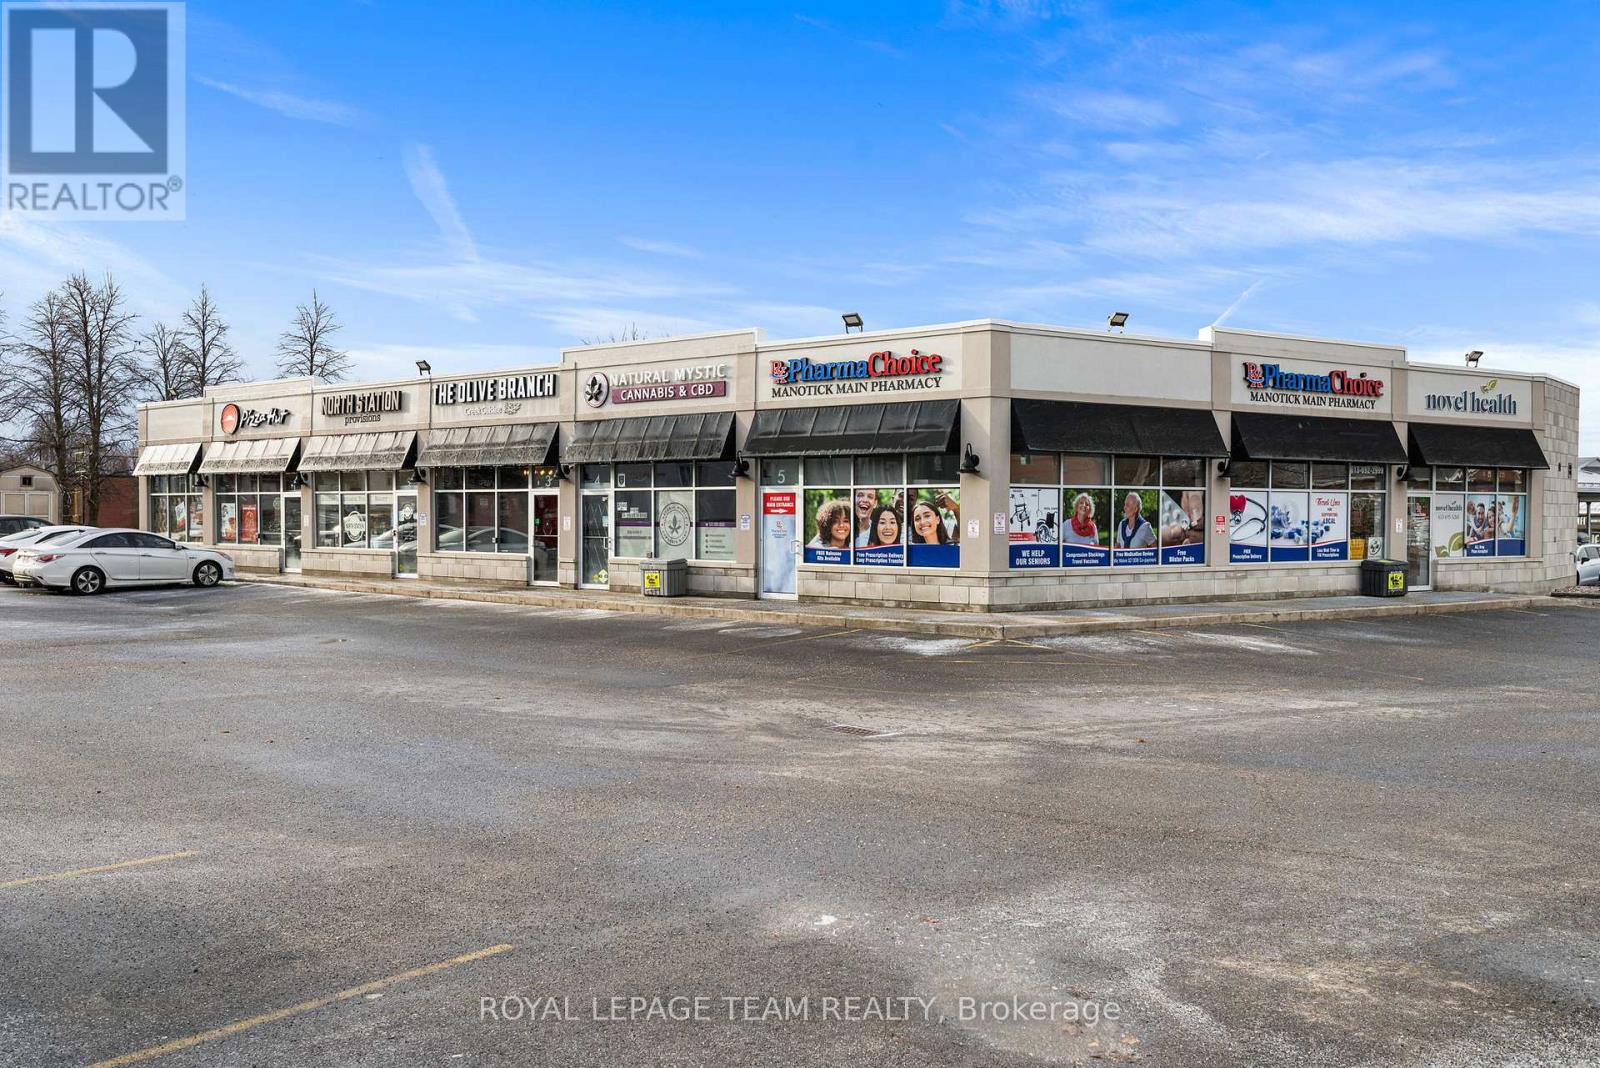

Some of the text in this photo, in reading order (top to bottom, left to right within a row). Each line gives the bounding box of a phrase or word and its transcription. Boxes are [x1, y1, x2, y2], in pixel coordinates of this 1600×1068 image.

[608, 364, 727, 387] NATURAL MYSTIC
[788, 349, 943, 383] PharmaChoice
[433, 374, 556, 405] THE OLIVE BRANCH
[772, 376, 942, 398] MANOTICK MAIN PHARMACY
[1261, 363, 1384, 397] PharmaChoice
[322, 390, 402, 415] NORTH STATION
[620, 384, 713, 401] CANNABIS & CBD
[1250, 391, 1376, 410] MANOTICK MAIN PHARMACY
[1425, 391, 1517, 415] novel health
[240, 407, 290, 427] Pizza Hut
[344, 414, 381, 426] provisions
[545, 476, 552, 487] 3
[777, 470, 786, 484] 5
[1028, 557, 1051, 565] SENIORS
[1031, 549, 1045, 557] HELP
